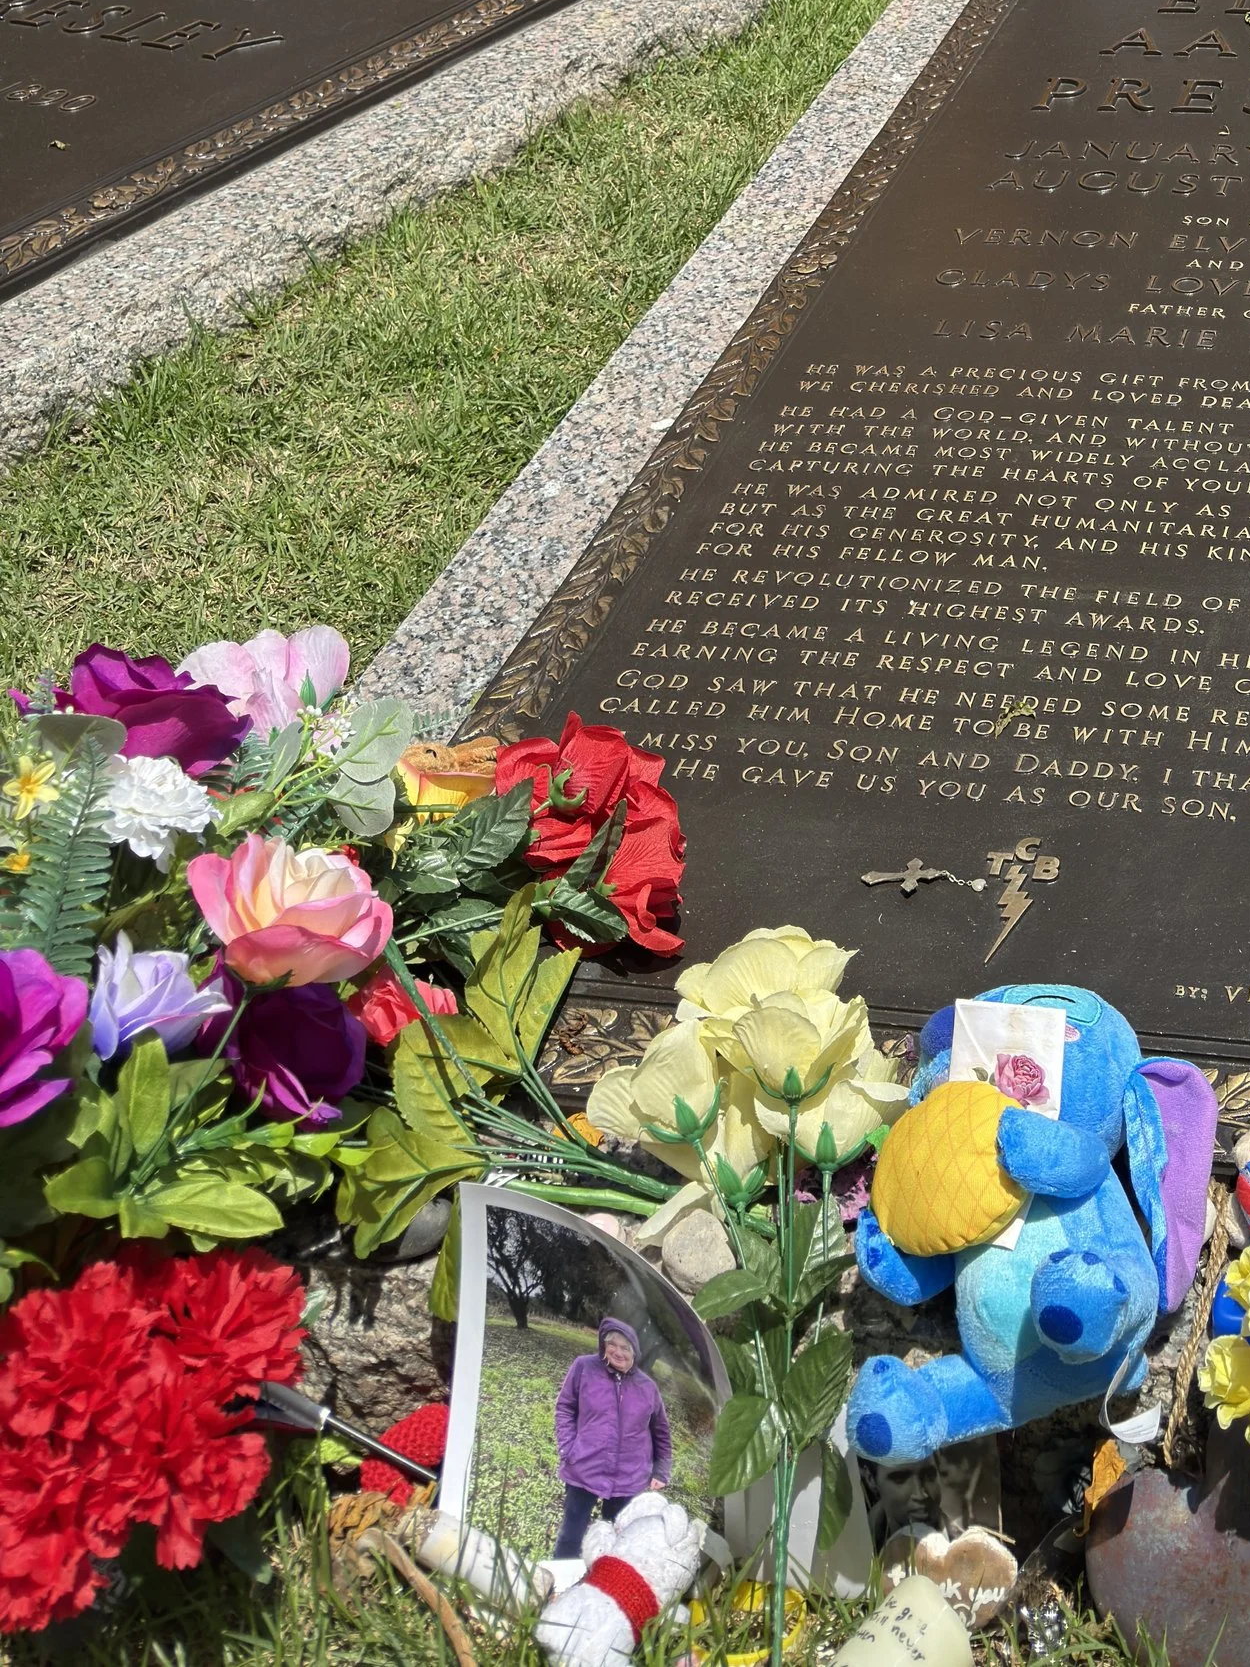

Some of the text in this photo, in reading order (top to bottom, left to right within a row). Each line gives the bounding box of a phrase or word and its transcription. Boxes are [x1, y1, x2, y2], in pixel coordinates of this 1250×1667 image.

[987, 170, 1243, 196] AUGUST
[1182, 214, 1231, 228] SON
[954, 227, 1138, 251] VERNON
[1186, 258, 1244, 272] AND
[935, 268, 1112, 292] GLADYS
[1127, 302, 1226, 320] FATHER
[933, 318, 1034, 343] LISA
[1065, 323, 1218, 351] MARIE
[807, 363, 839, 376] HE
[854, 364, 906, 377] WAS
[919, 365, 937, 377] A
[951, 365, 1083, 383] PRECIOUS
[1099, 372, 1165, 387] GIFT
[1178, 377, 1250, 392] FROM
[799, 379, 833, 393] WE
[849, 380, 1001, 396] CHERISHED
[1016, 386, 1074, 400] AND
[1091, 389, 1183, 407] LOVED
[780, 404, 814, 418] HE
[829, 405, 887, 419] HAD
[900, 407, 918, 421] A
[1127, 417, 1234, 436] TALENT
[679, 568, 718, 584] HE
[731, 569, 1003, 596] REVOLUTIONIZED
[1021, 583, 1078, 602] THE
[1095, 589, 1184, 609] FIELD
[1201, 596, 1242, 612] OF
[664, 590, 1205, 635] RECEIVED ITS HIGHEST AWARDS.
[708, 676, 778, 695] SAW
[794, 680, 882, 702] THAT
[898, 687, 940, 706] HE
[954, 691, 1082, 715] NEEDED
[1101, 700, 1191, 724] SOME
[637, 731, 719, 753] MISS
[736, 737, 810, 758] YOU,
[918, 750, 991, 772] AND
[1163, 767, 1172, 785] I
[741, 766, 835, 788] GAVE
[856, 775, 897, 794] US
[917, 778, 988, 801] YOU
[1003, 785, 1046, 805] AS
[1068, 789, 1144, 813] OUR
[1160, 796, 1238, 823] SON.
